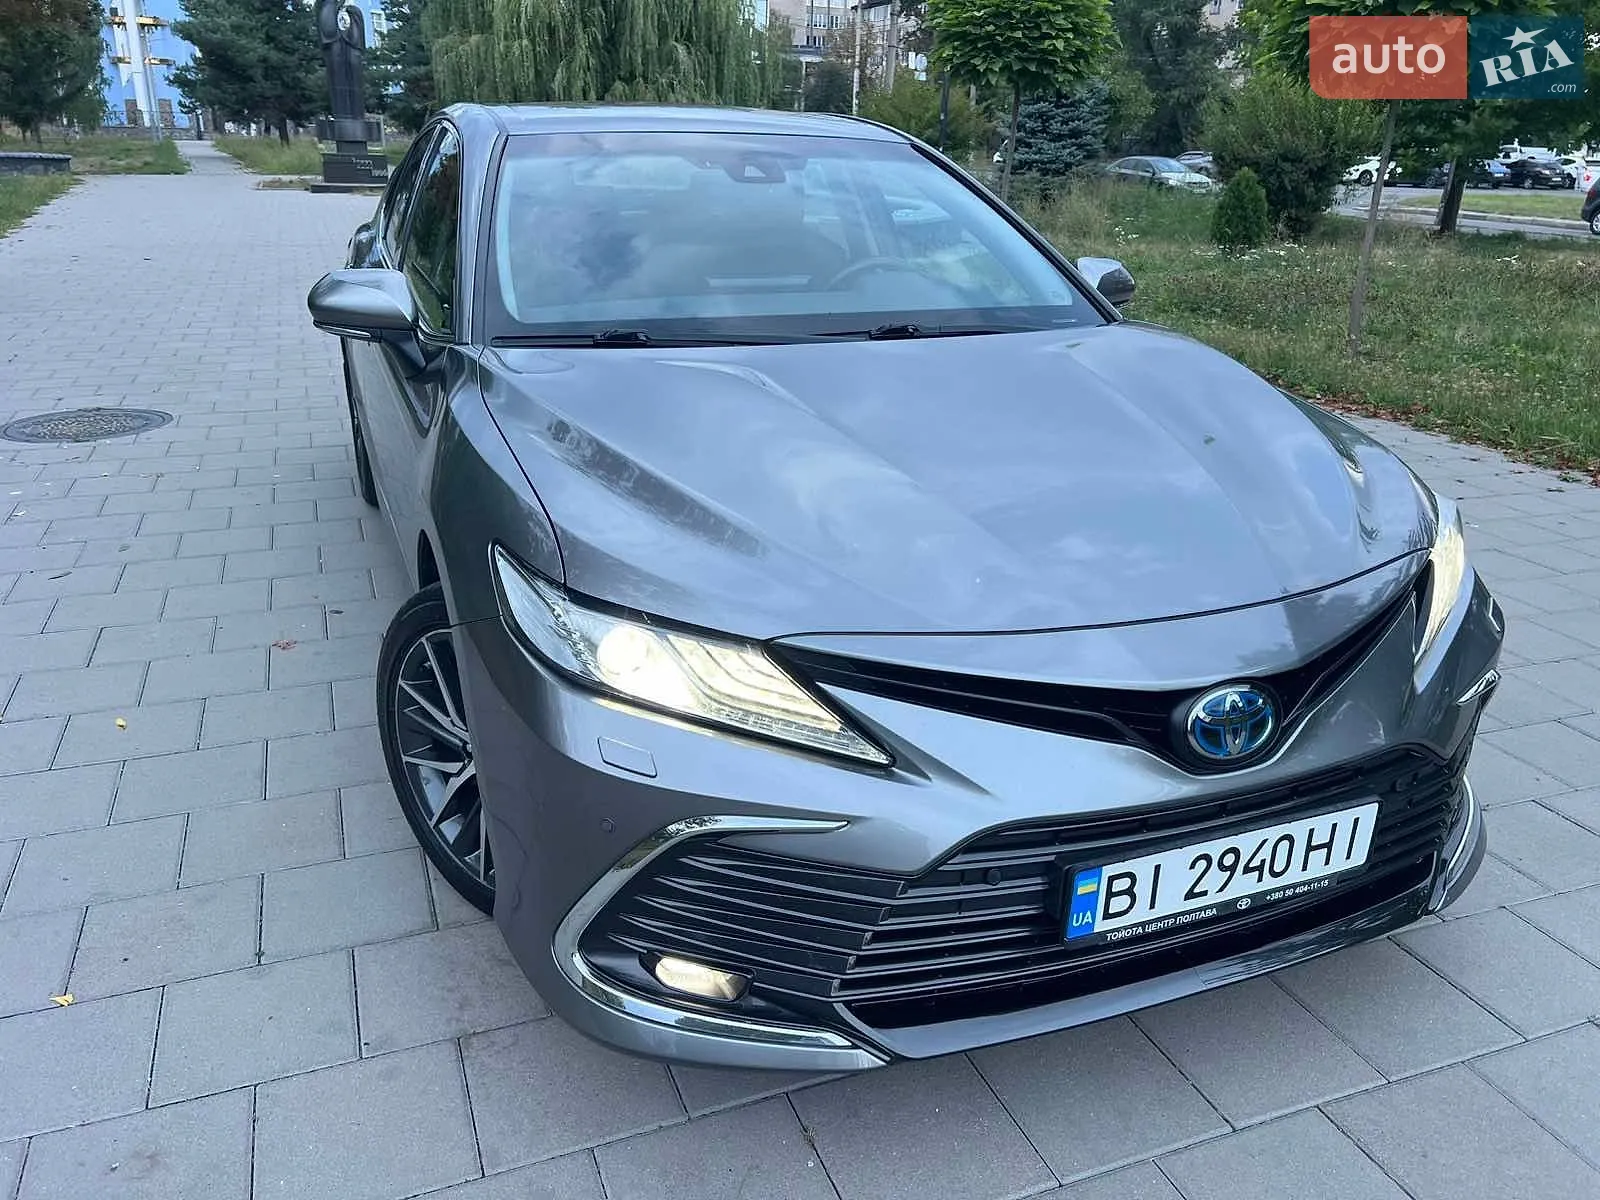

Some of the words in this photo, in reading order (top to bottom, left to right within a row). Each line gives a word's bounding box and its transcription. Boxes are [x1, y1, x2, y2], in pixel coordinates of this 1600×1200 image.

[1266, 891, 1283, 901] +380
[1072, 910, 1093, 927] UA
[1144, 918, 1176, 933] ЦЕНТР
[1176, 907, 1218, 925] ПОЛТАВА
